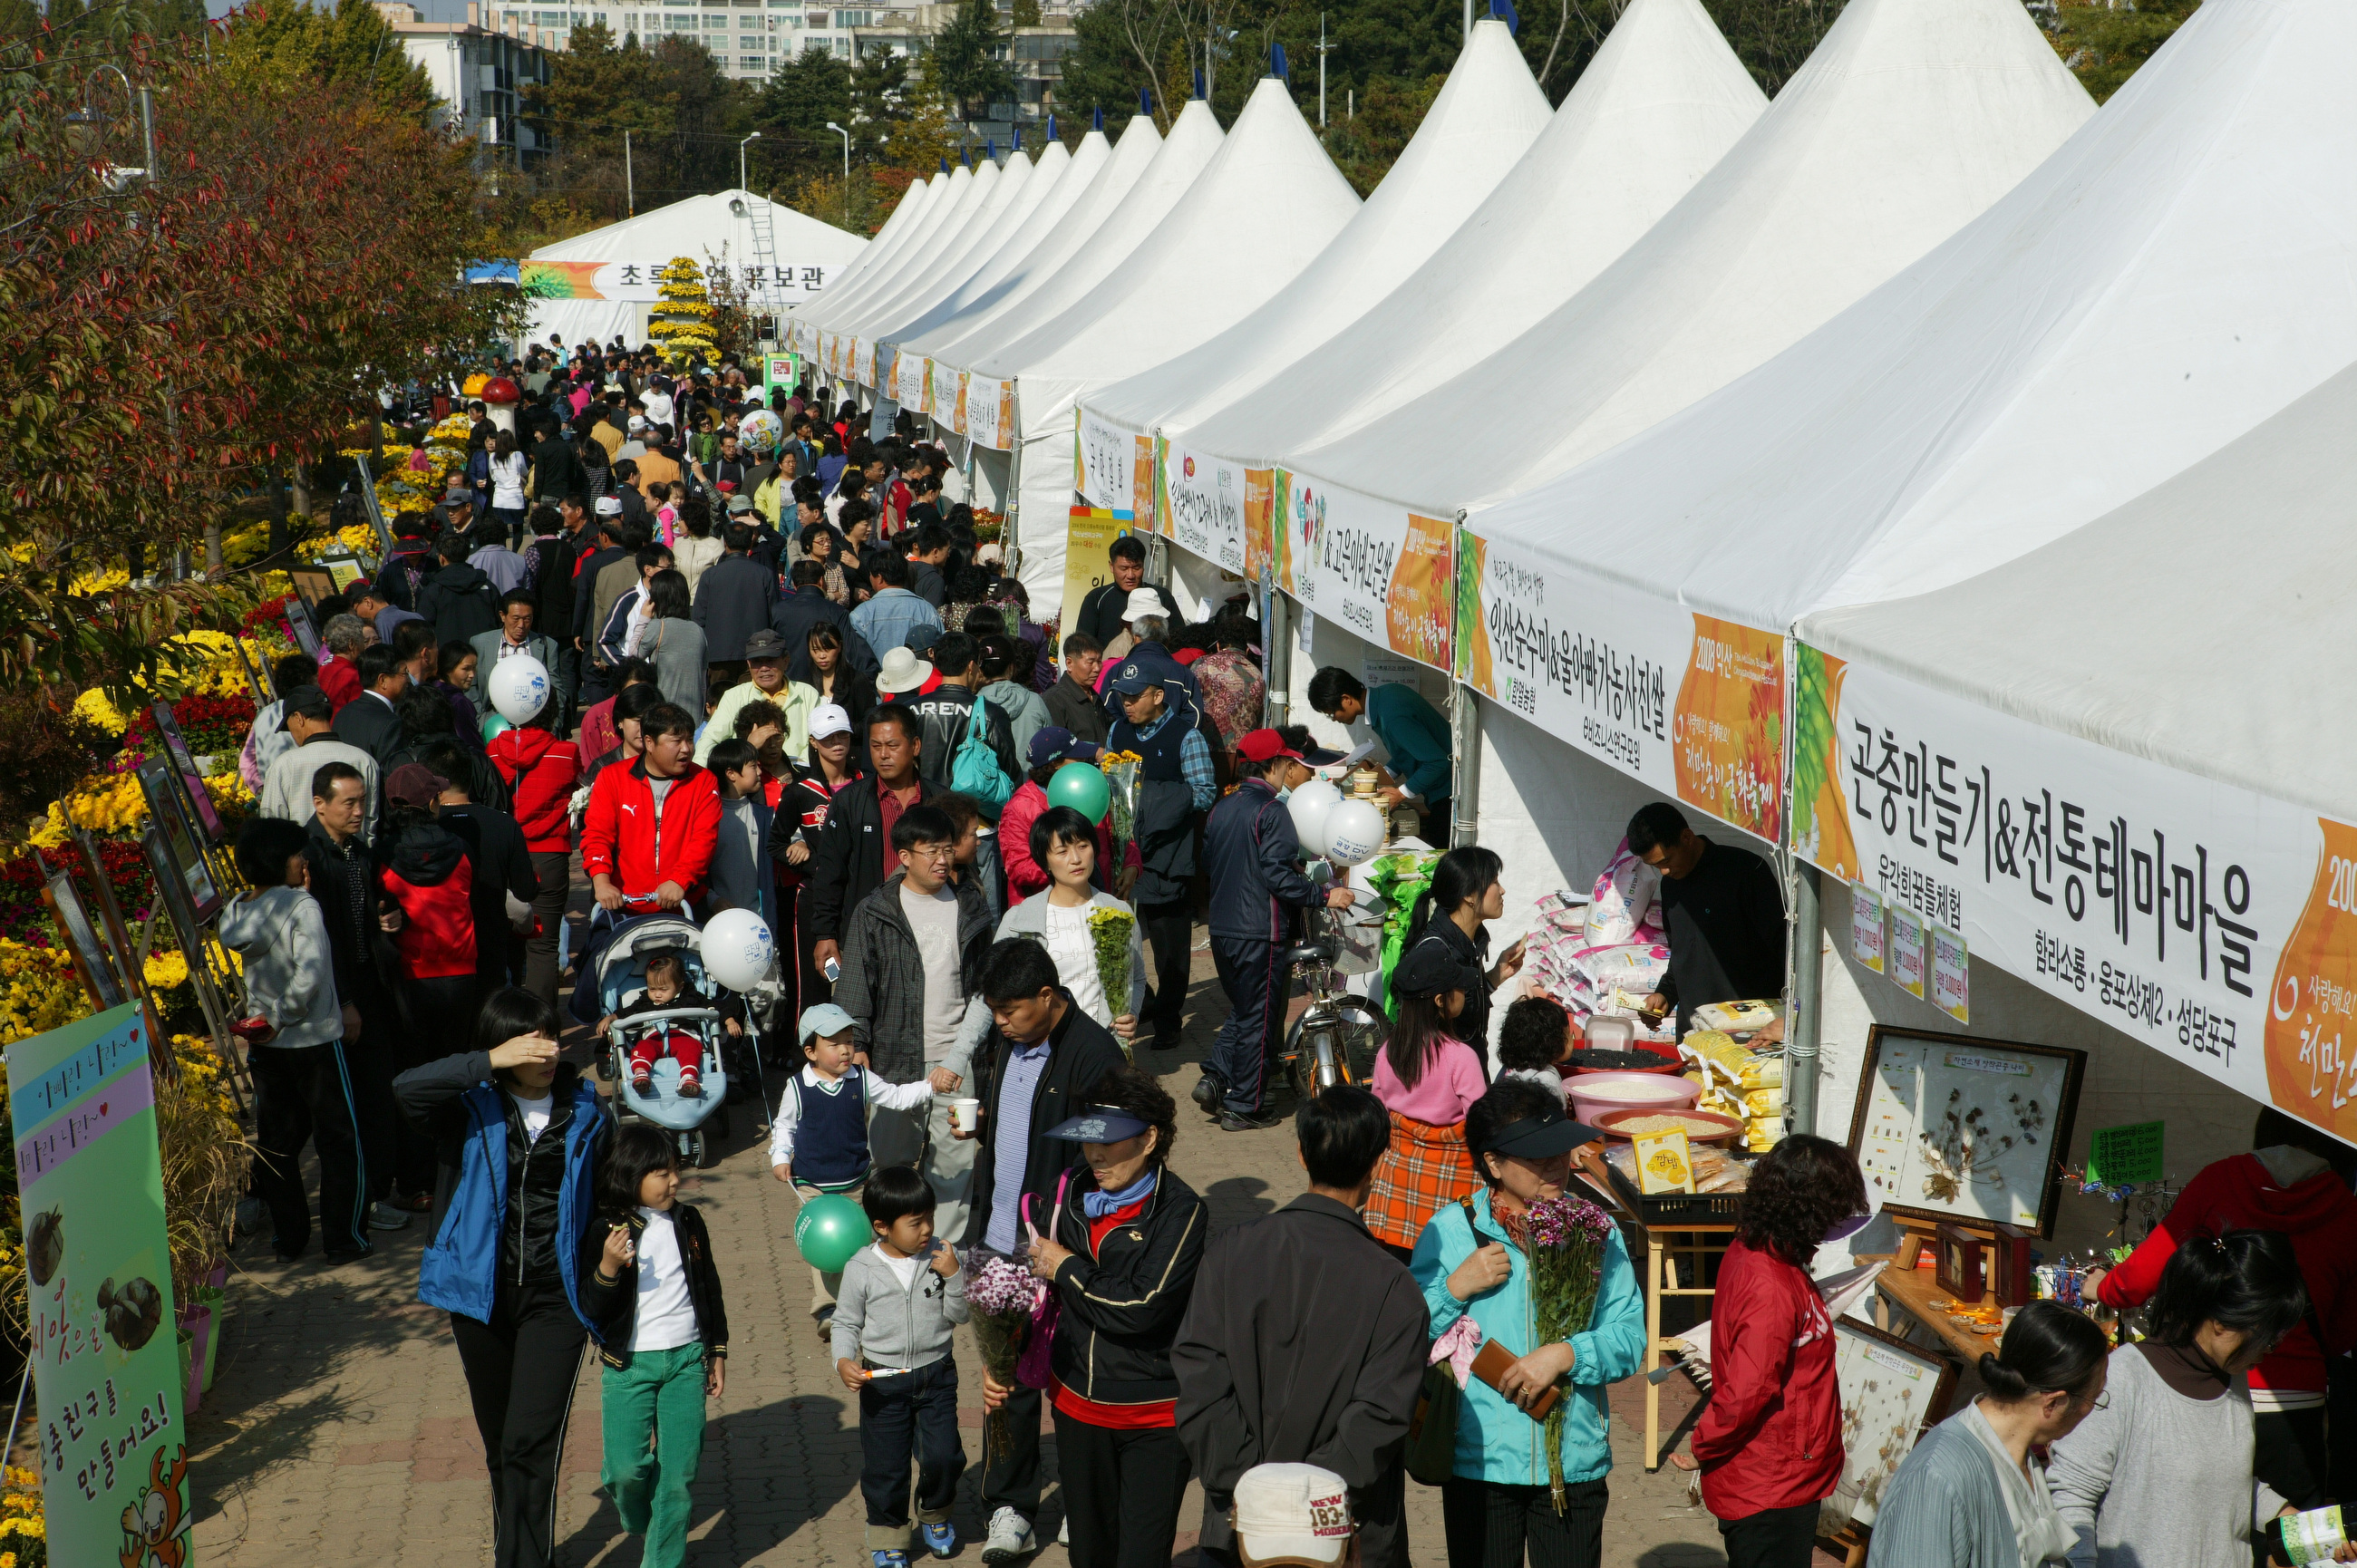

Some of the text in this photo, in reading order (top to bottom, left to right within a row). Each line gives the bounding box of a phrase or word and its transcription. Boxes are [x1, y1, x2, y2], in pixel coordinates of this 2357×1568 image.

[1583, 716, 1641, 771] e비즈니스연구모임
[1686, 712, 1731, 745] 사랑해요! 함께해요!
[1685, 737, 1773, 818] 천만송이 국화축제
[1850, 716, 2259, 998] 곤충만들기&전통테마마을
[2308, 974, 2357, 1020] 사랑해요!
[37, 1060, 82, 1109] 아빠랑
[1654, 1153, 1679, 1169] 깜밥
[77, 1392, 169, 1502] 만들어요!
[1310, 1494, 1343, 1508] NEW
